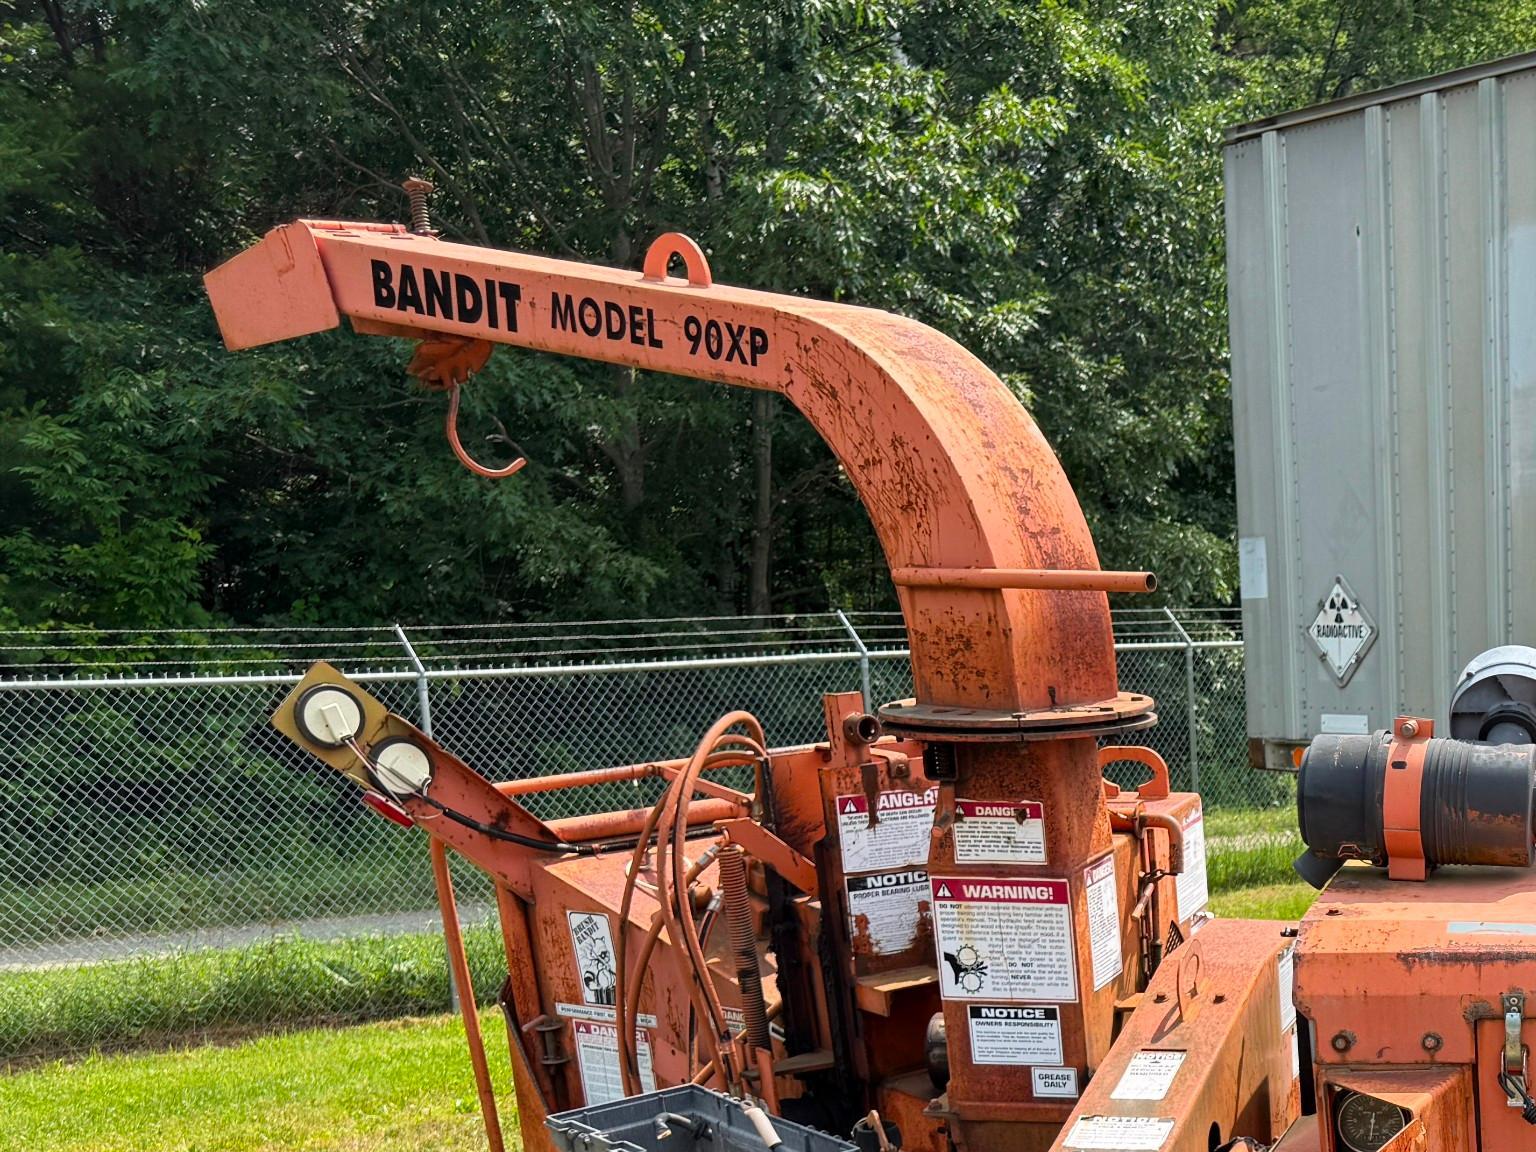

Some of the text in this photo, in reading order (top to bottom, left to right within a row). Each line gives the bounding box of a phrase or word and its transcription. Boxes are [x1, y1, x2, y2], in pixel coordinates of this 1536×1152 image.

[371, 259, 769, 367] BANDIT MODEL 90XP
[1316, 625, 1363, 638] RADIOACTIVE
[879, 790, 937, 809] ANGER!
[975, 806, 1030, 818] DANGE!
[867, 871, 927, 888] NOTIC
[962, 884, 1053, 900] WARNING!
[574, 914, 594, 937] BRUSH
[576, 922, 600, 945] BANDIT
[980, 1008, 1046, 1019] NOTICE
[1038, 1073, 1071, 1081] GREASE
